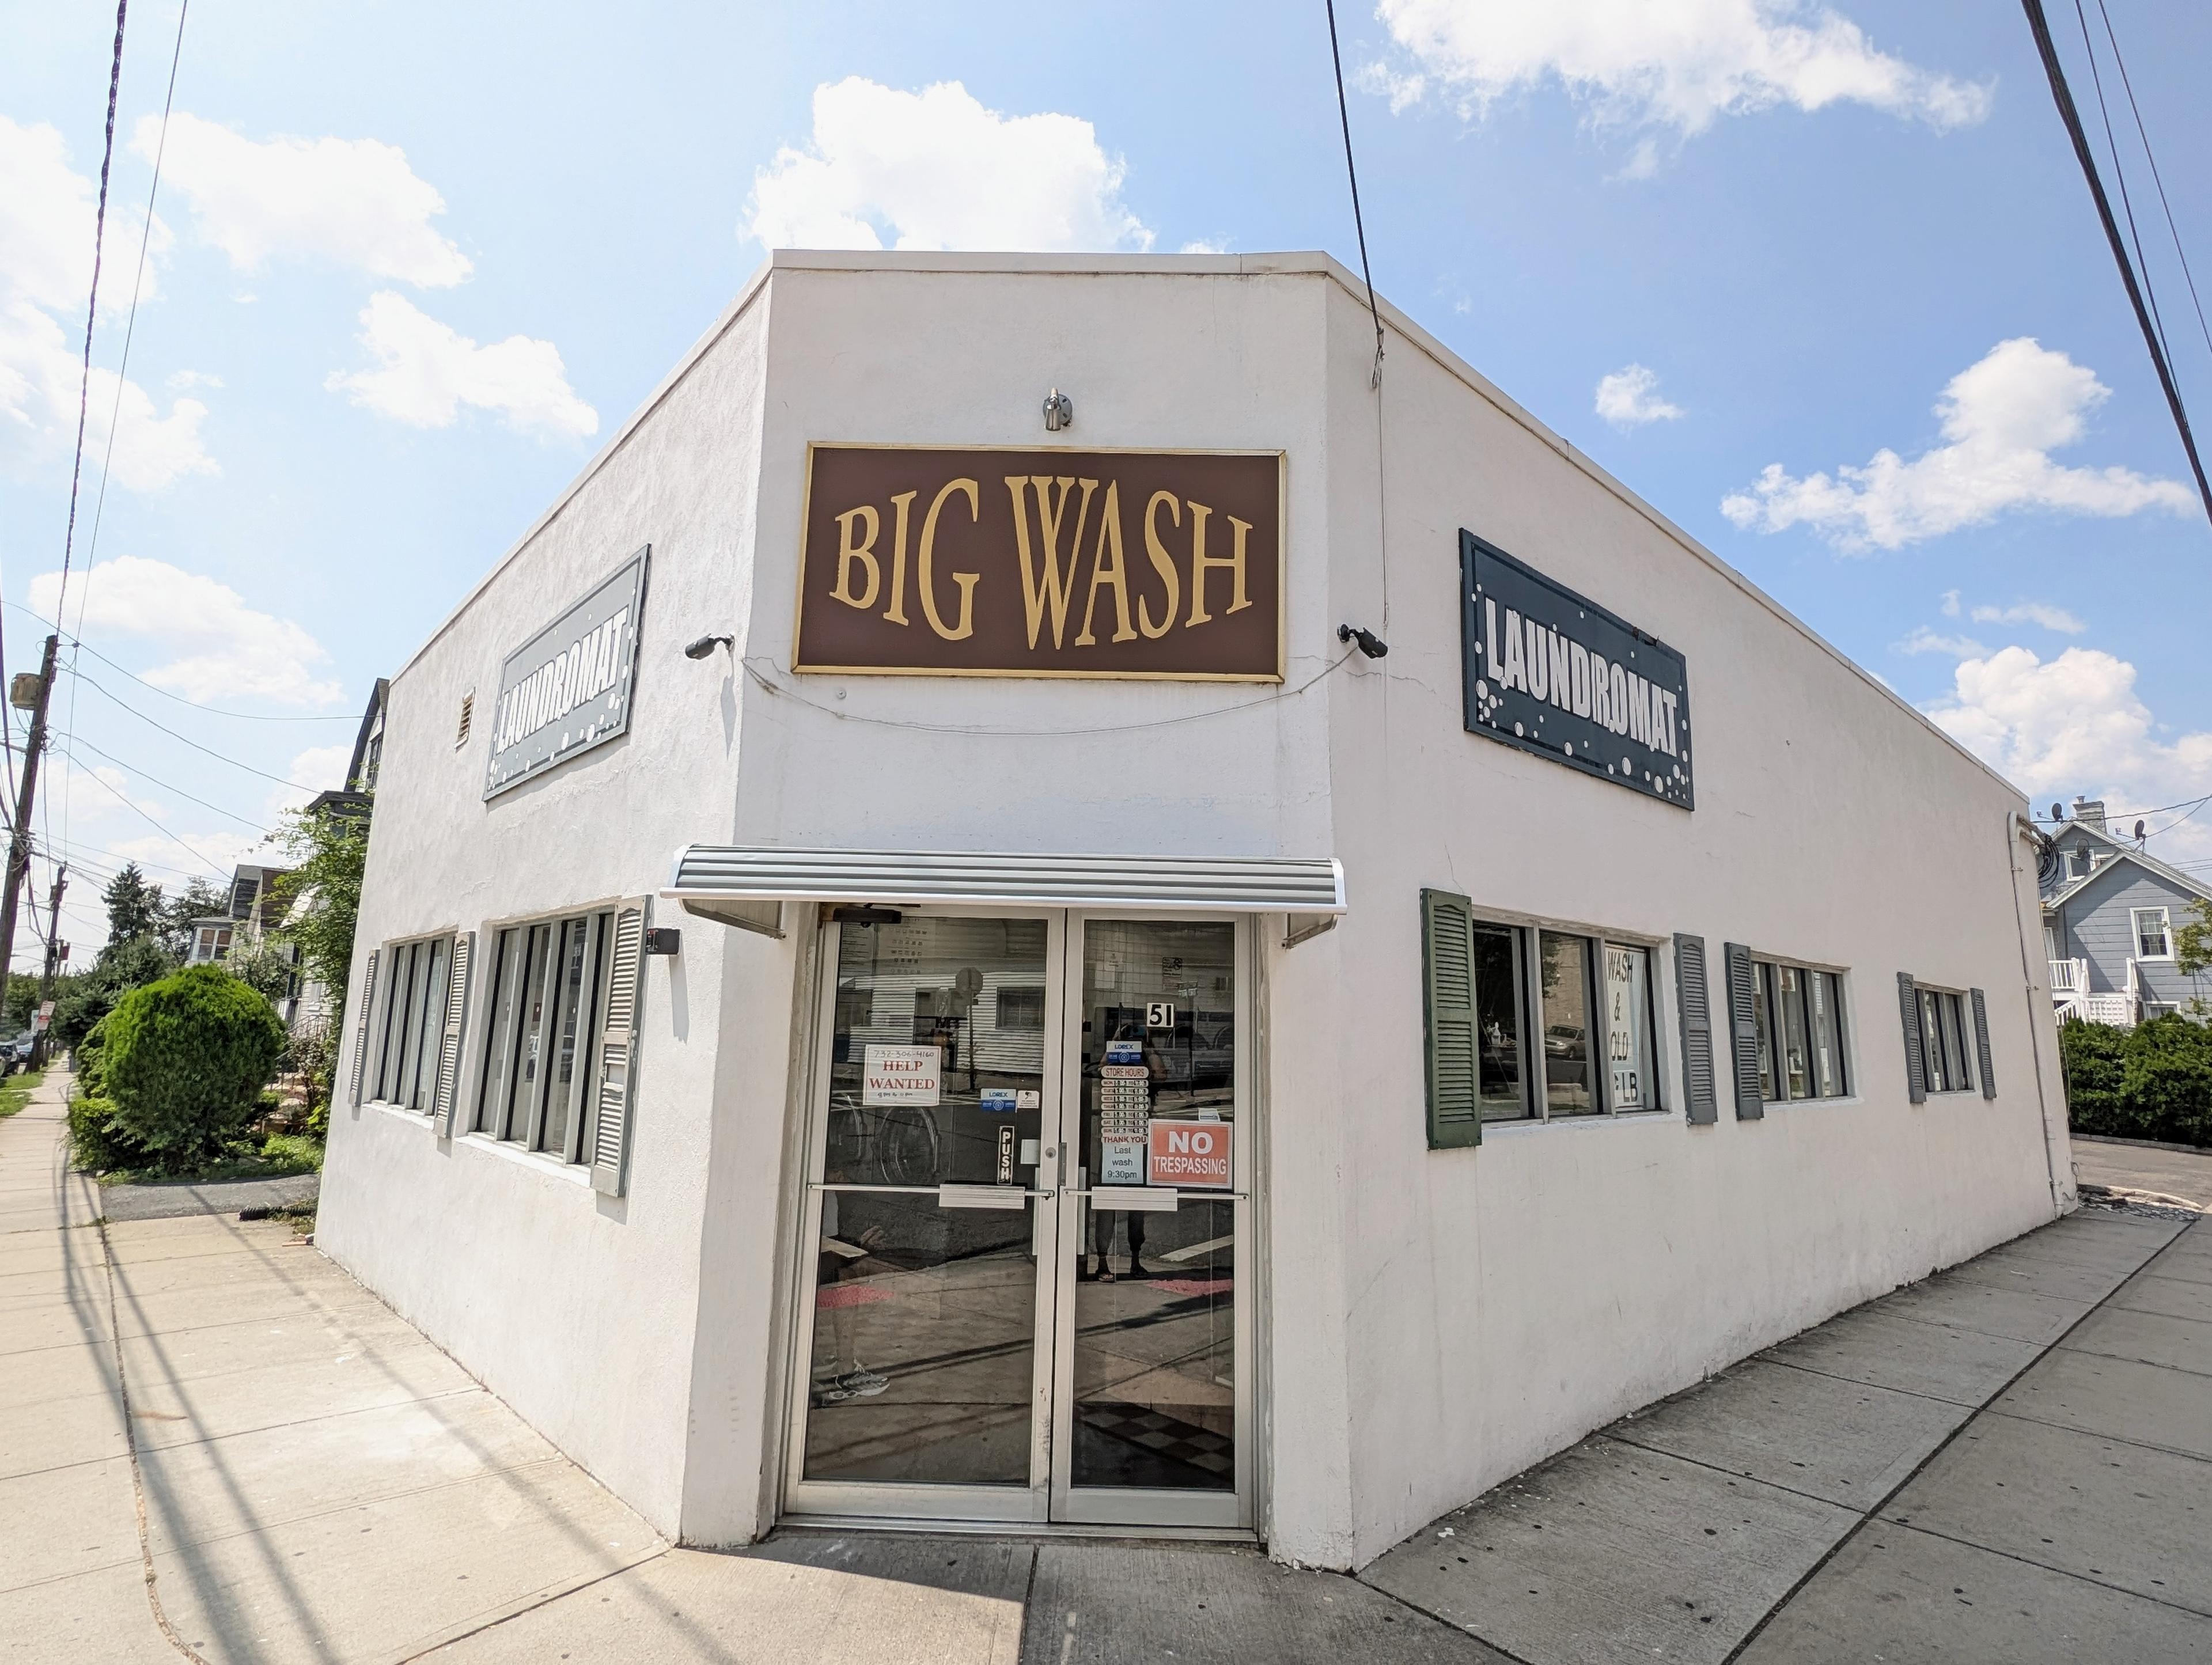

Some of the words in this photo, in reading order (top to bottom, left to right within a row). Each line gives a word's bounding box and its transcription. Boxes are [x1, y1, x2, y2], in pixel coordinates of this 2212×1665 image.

[829, 477, 980, 640] BIG
[1004, 475, 1252, 650] WASH
[497, 607, 628, 754] LAUNDROMAT
[1484, 597, 1677, 757] LAUNDROMAT
[1608, 951, 1634, 983] WASH
[1150, 1004, 1172, 1026] 51
[1615, 992, 1621, 1022] &
[1611, 1031, 1628, 1061] OLD
[883, 1060, 923, 1071] HELP
[1106, 1068, 1124, 1077] STORE
[1125, 1068, 1144, 1078] HOURS
[869, 1078, 935, 1090] WANTED
[1114, 1146, 1131, 1154] Last
[1168, 1131, 1213, 1154] NO
[1001, 1131, 1011, 1181] PUSH
[1154, 1156, 1226, 1175] TRESPASSING
[1107, 1170, 1137, 1179] 9:30pm
